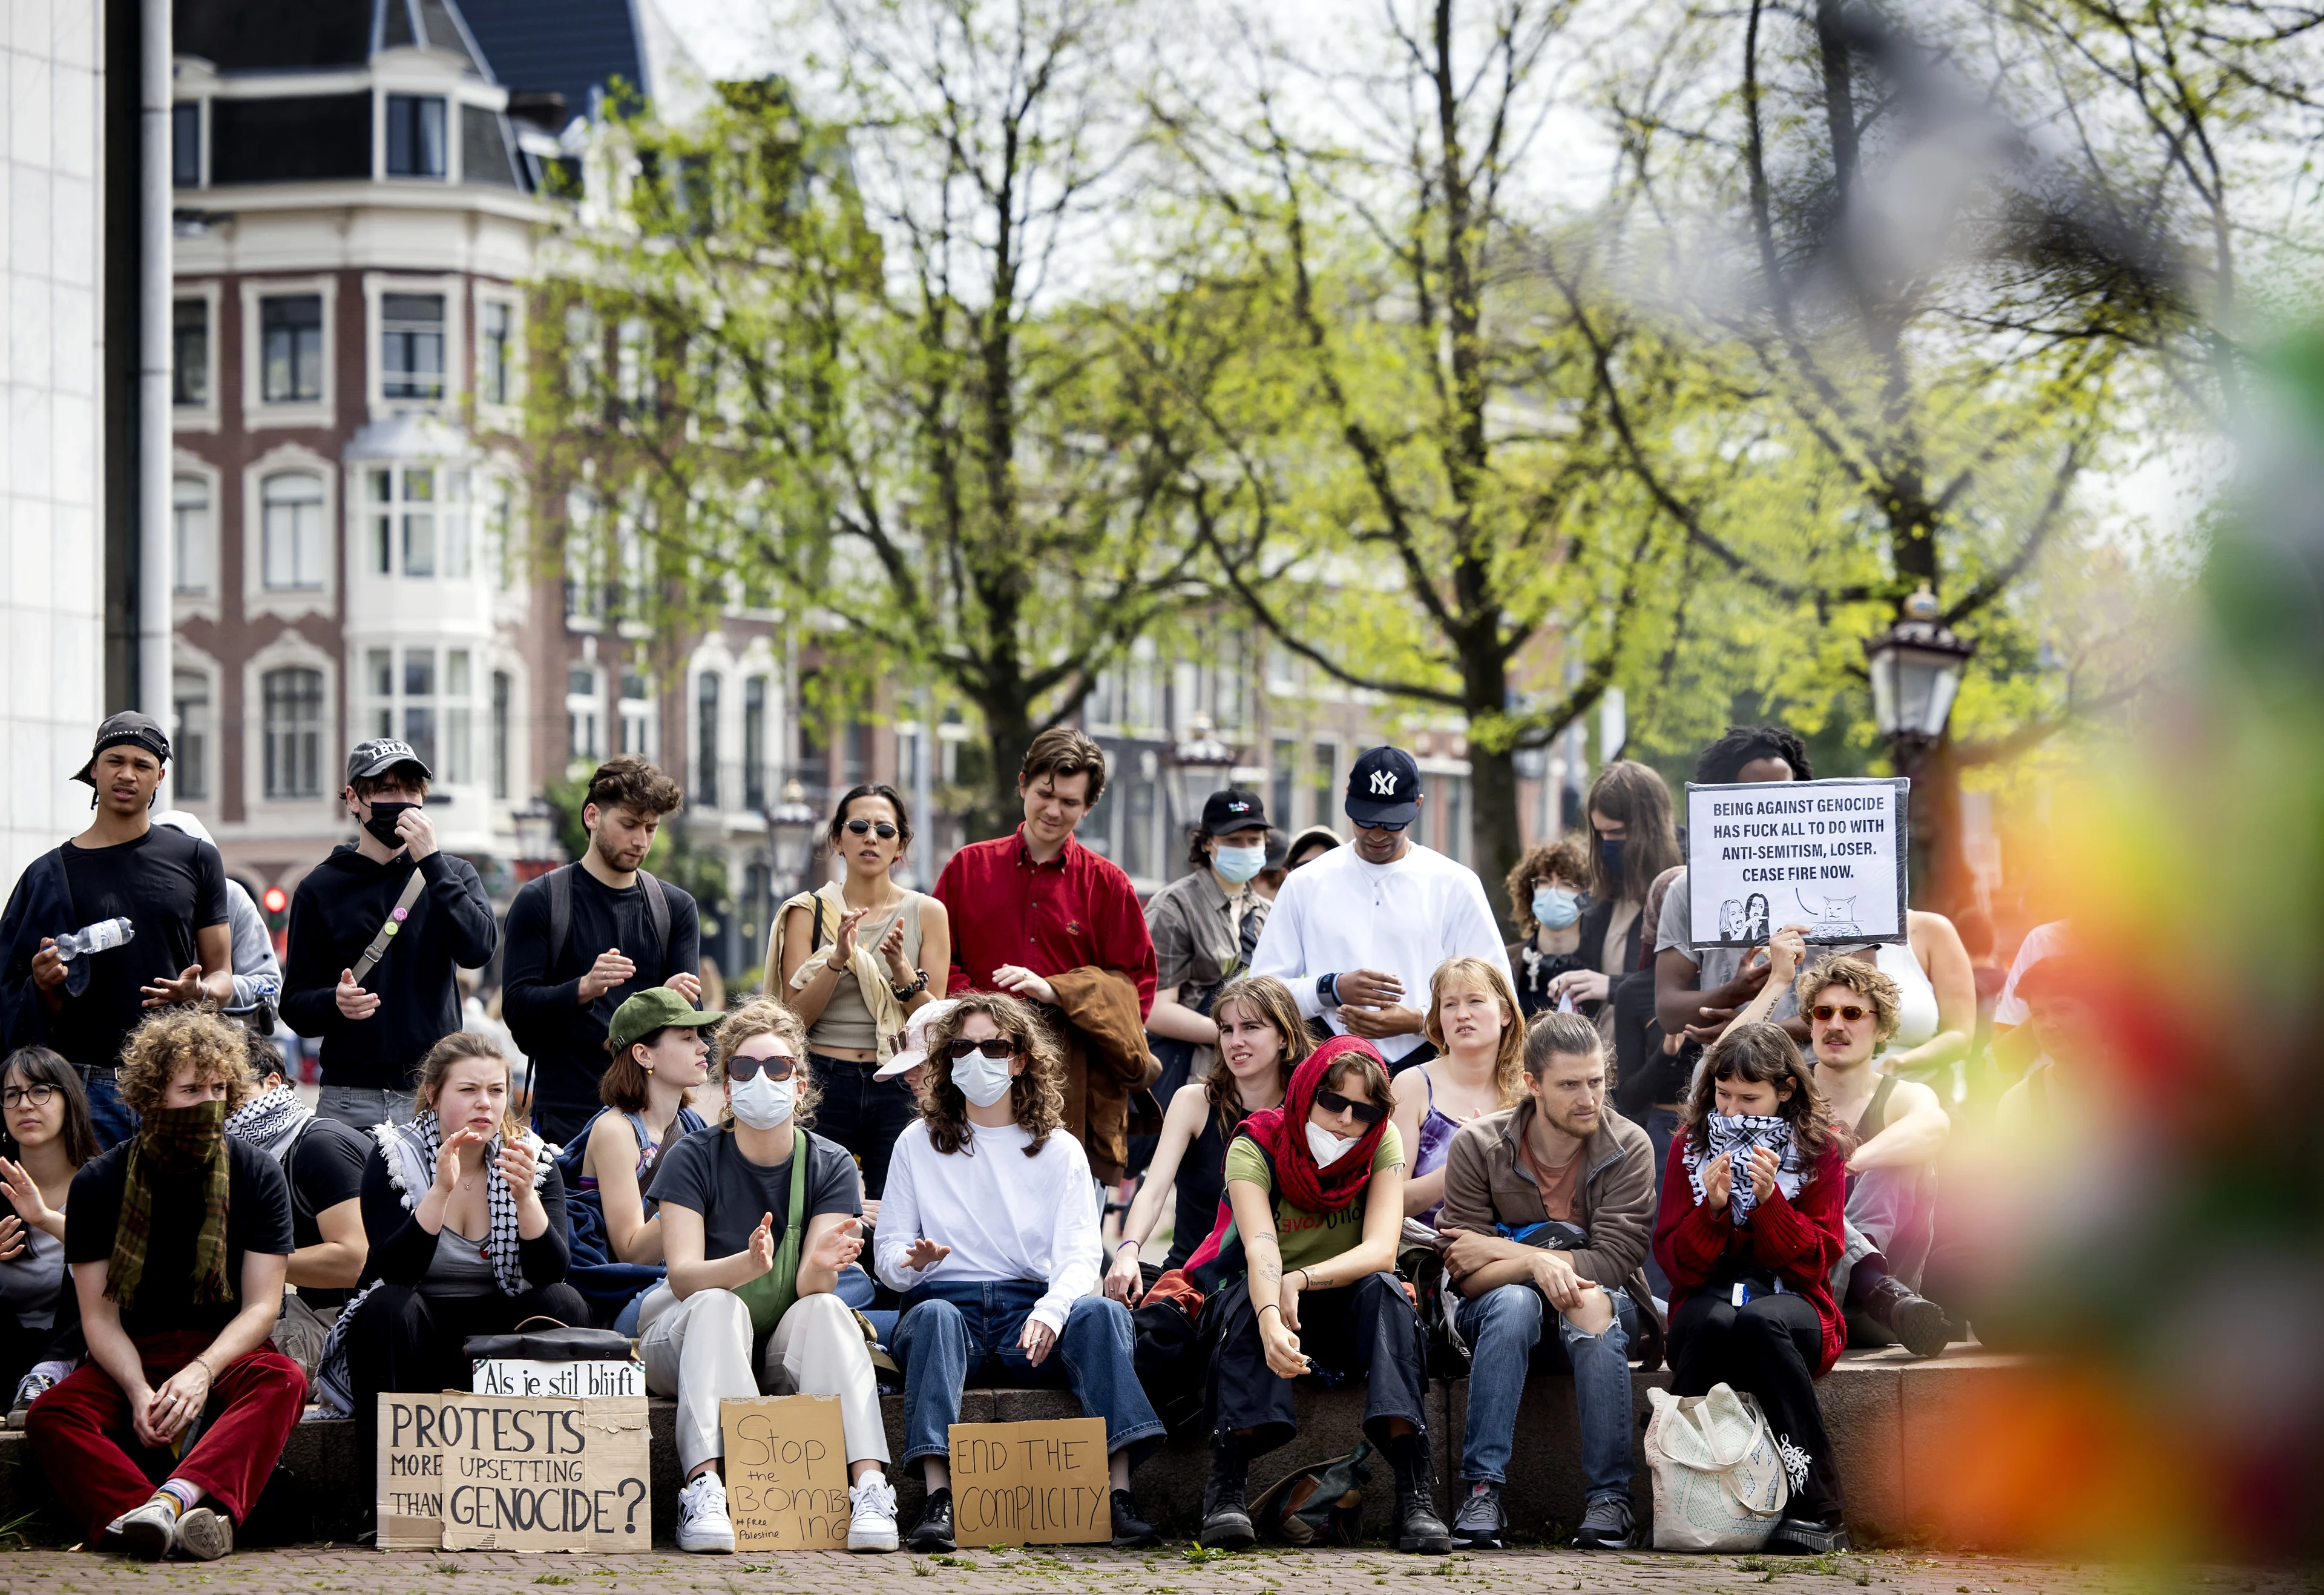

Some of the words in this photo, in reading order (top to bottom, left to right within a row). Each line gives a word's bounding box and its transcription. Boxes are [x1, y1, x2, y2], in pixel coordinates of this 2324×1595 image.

[1370, 769, 1398, 795] NY
[1713, 802, 1753, 817] BEING
[1756, 800, 1813, 815] AGAINST
[1817, 797, 1884, 812] GENOCIDE
[1713, 824, 1740, 838] HAS
[1744, 823, 1778, 838] FUCK
[1781, 822, 1805, 836] ALL
[1808, 821, 1825, 835] TO
[1829, 820, 1846, 834] DO
[1850, 819, 1884, 834] WITH
[1722, 844, 1827, 860] ANTI-SEMITISM,
[1830, 842, 1877, 857] LOSER.
[1742, 867, 1784, 882] CEASE
[1788, 866, 1816, 880] FIRE
[1820, 865, 1854, 879] NOW.
[484, 1363, 514, 1395] Als
[523, 1370, 540, 1396] je
[548, 1363, 579, 1395] stil
[588, 1363, 634, 1396] blijft
[390, 1403, 585, 1455] PROTESTS
[737, 1414, 826, 1480] Stop
[1017, 1438, 1089, 1472] THE
[390, 1454, 444, 1476] MORE
[460, 1456, 583, 1483] UPSETTING
[747, 1470, 780, 1482] the
[389, 1492, 442, 1517] THAN
[450, 1478, 646, 1534] GENOCIDE?
[739, 1529, 780, 1540] Palestine
